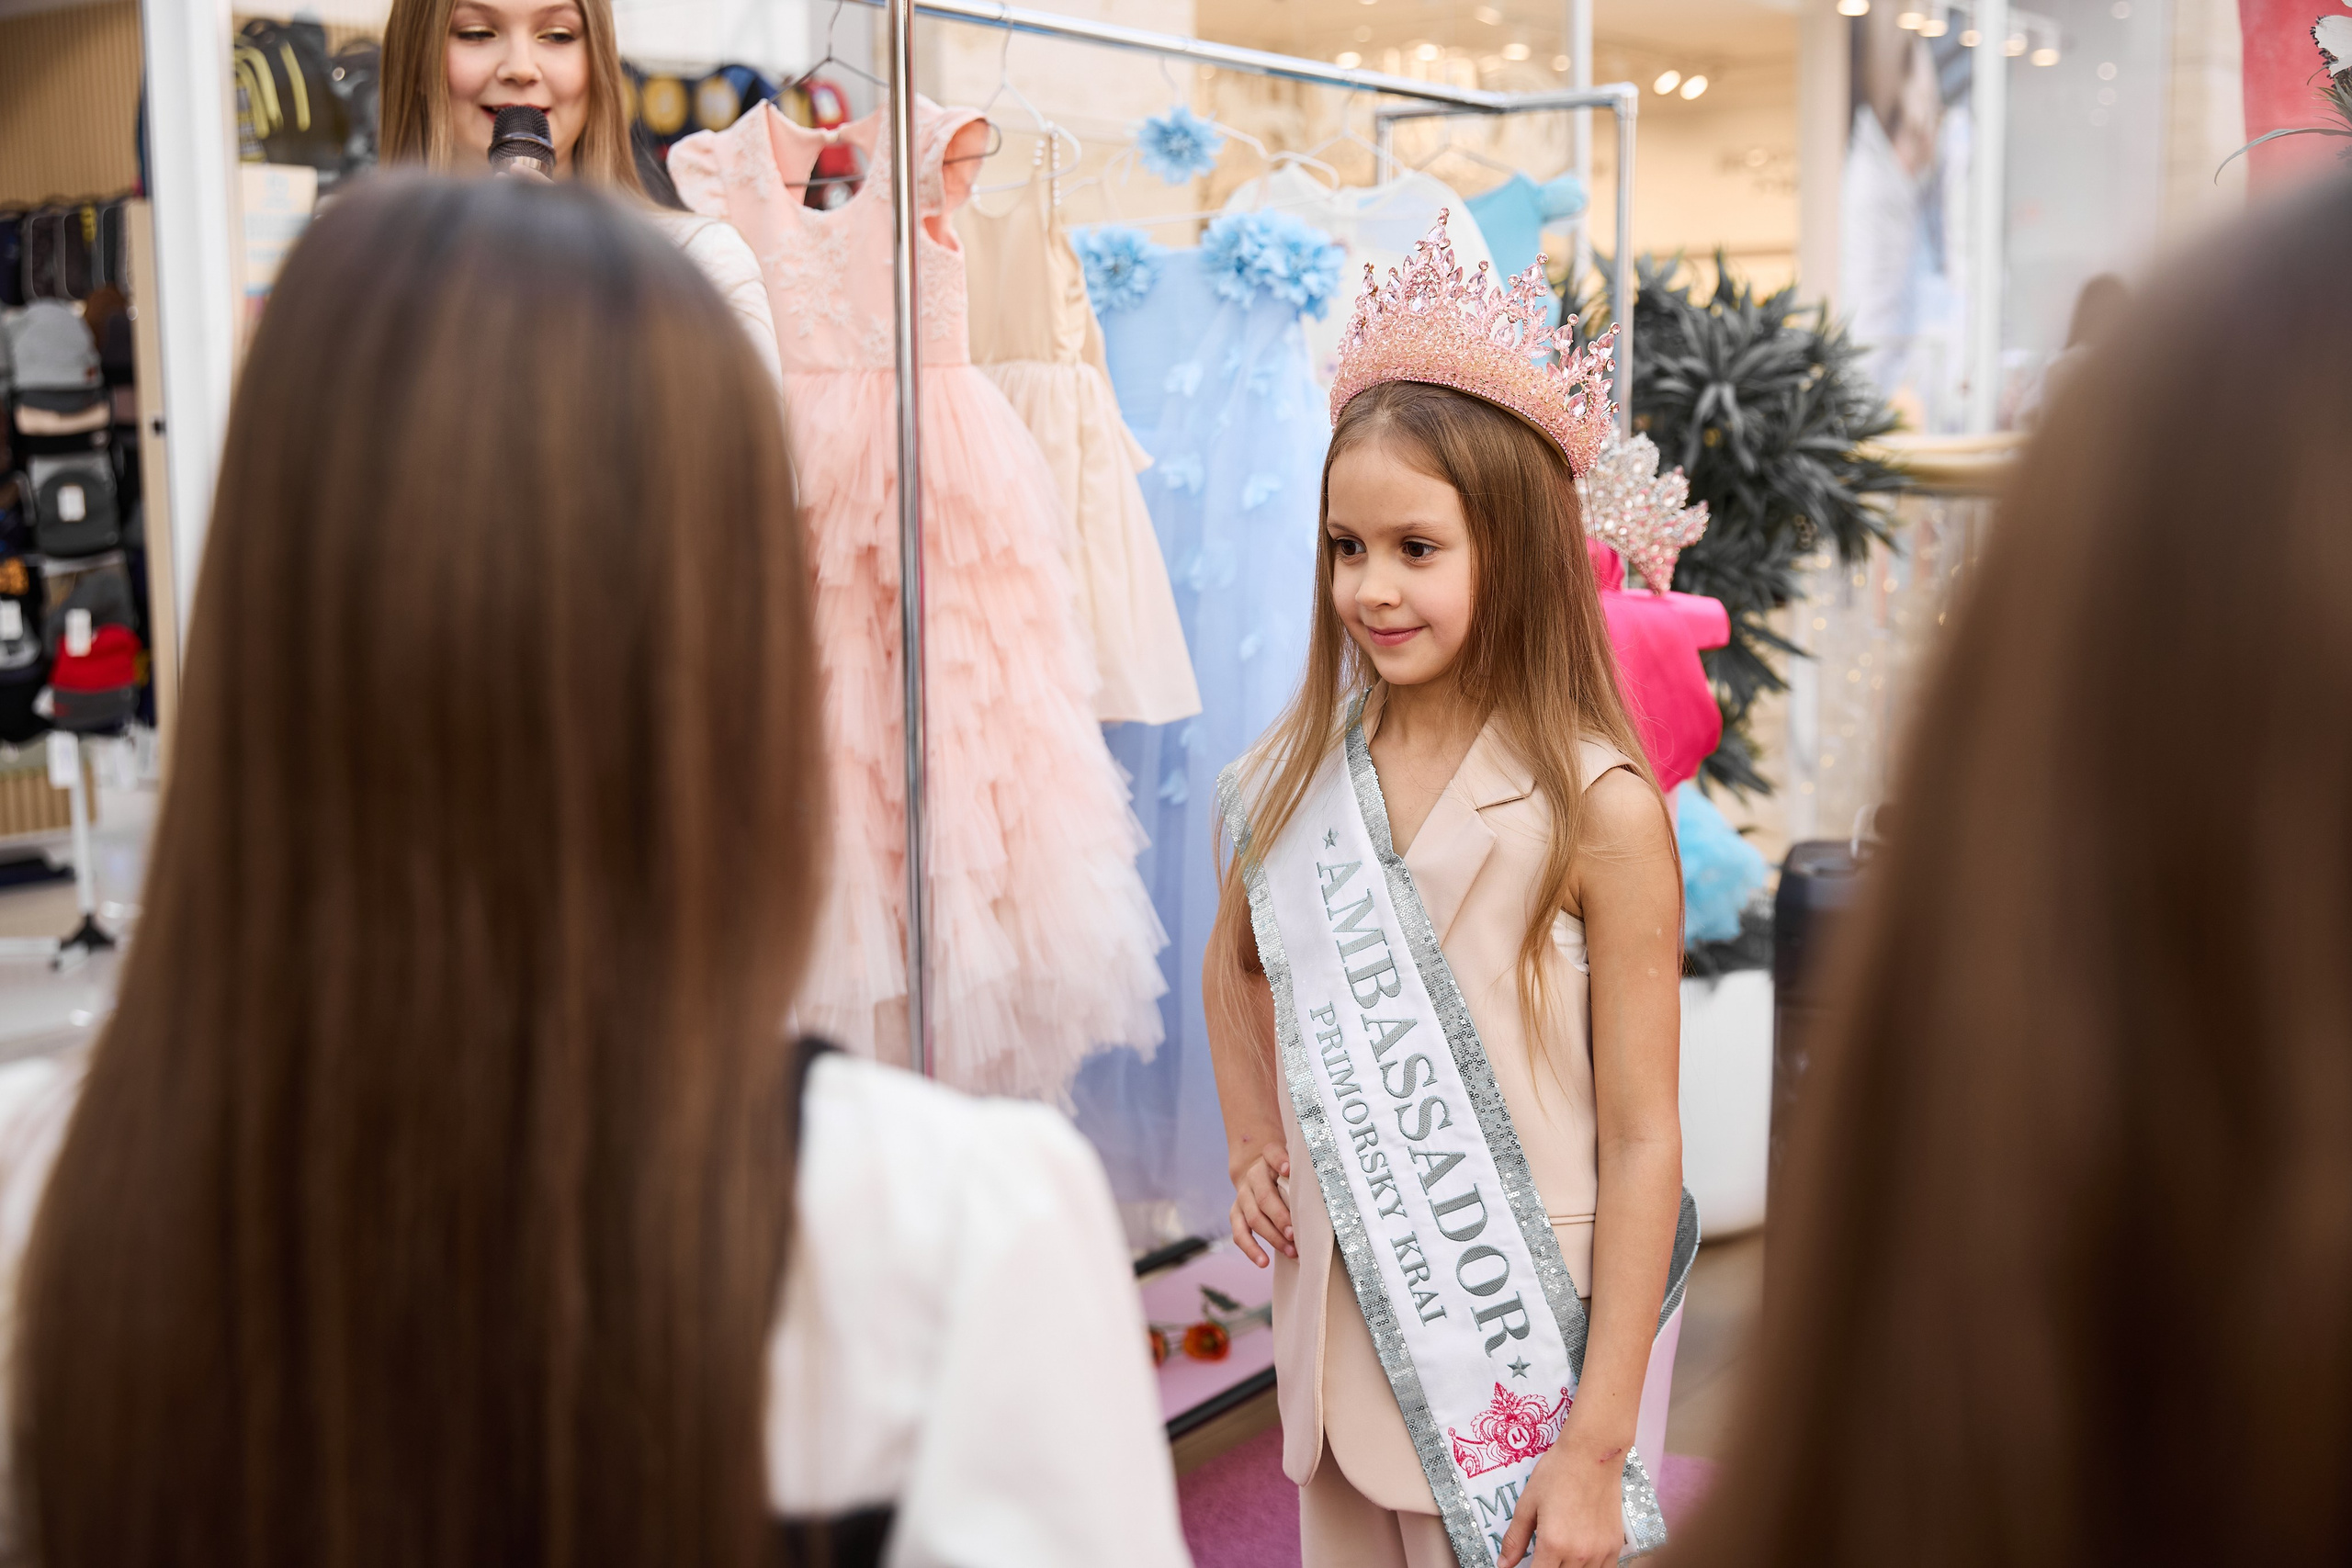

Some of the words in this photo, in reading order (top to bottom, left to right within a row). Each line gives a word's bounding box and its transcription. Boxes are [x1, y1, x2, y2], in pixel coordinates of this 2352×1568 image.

[1309, 1000, 1408, 1220] PRIMORSKY
[1390, 1231, 1447, 1326] KRAI
[1317, 860, 1531, 1359] AMBASSADOR
